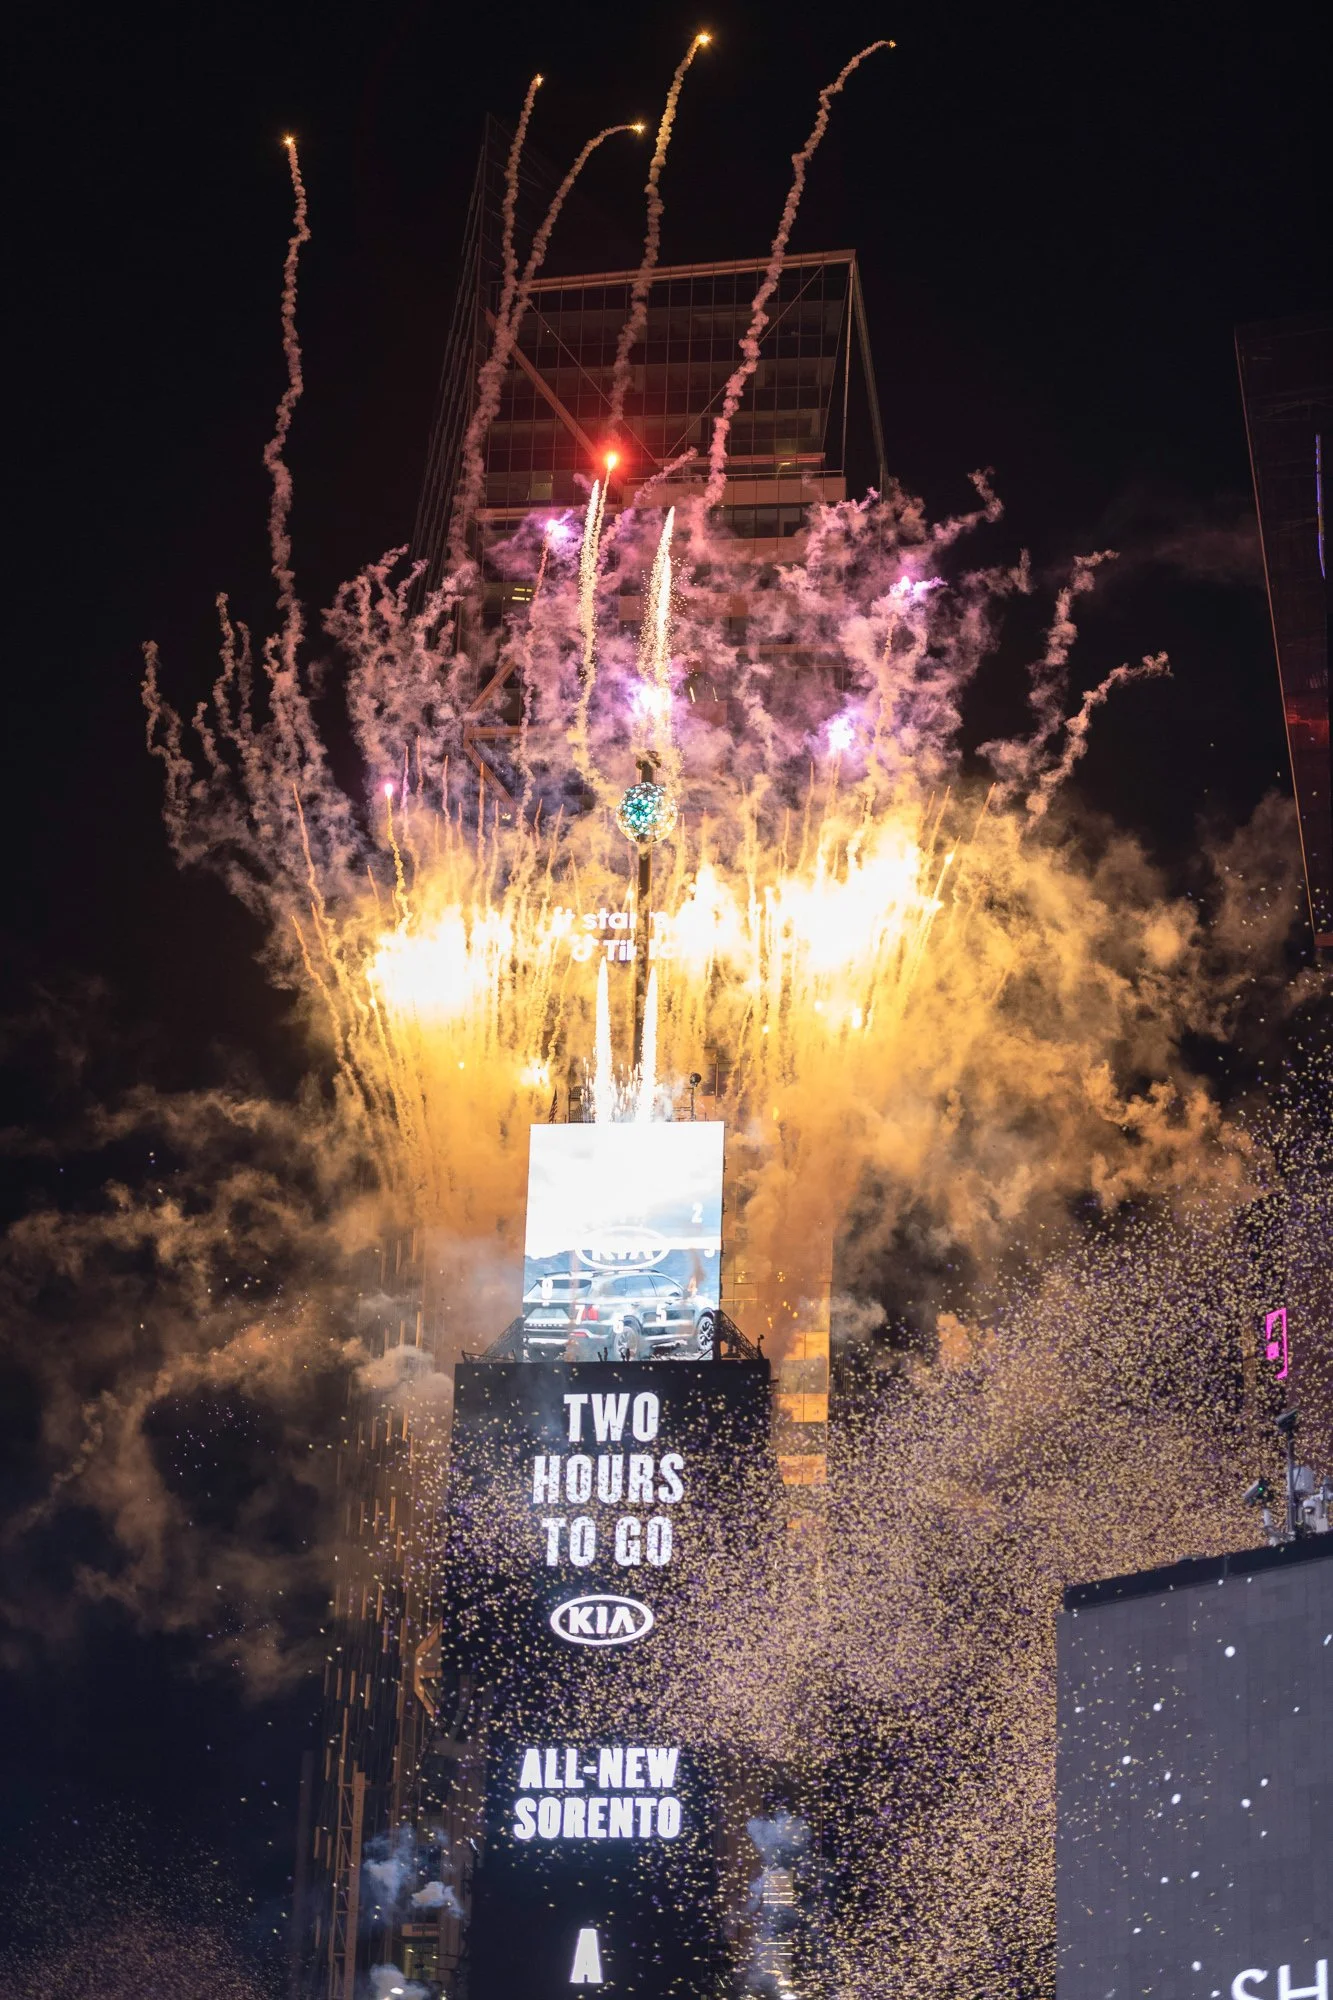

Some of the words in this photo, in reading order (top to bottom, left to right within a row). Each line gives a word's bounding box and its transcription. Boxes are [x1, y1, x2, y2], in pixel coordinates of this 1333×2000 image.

[691, 1202, 703, 1223] 2
[575, 1303, 585, 1325] 7
[656, 1303, 667, 1323] 5
[563, 1392, 659, 1442] TWO
[533, 1453, 685, 1504] HOURS
[542, 1516, 596, 1567] TO
[614, 1516, 673, 1566] GO
[568, 1606, 636, 1634] KIA
[519, 1748, 679, 1789] ALL-NEW
[513, 1797, 681, 1839] SORENTO
[570, 1928, 603, 1983] A
